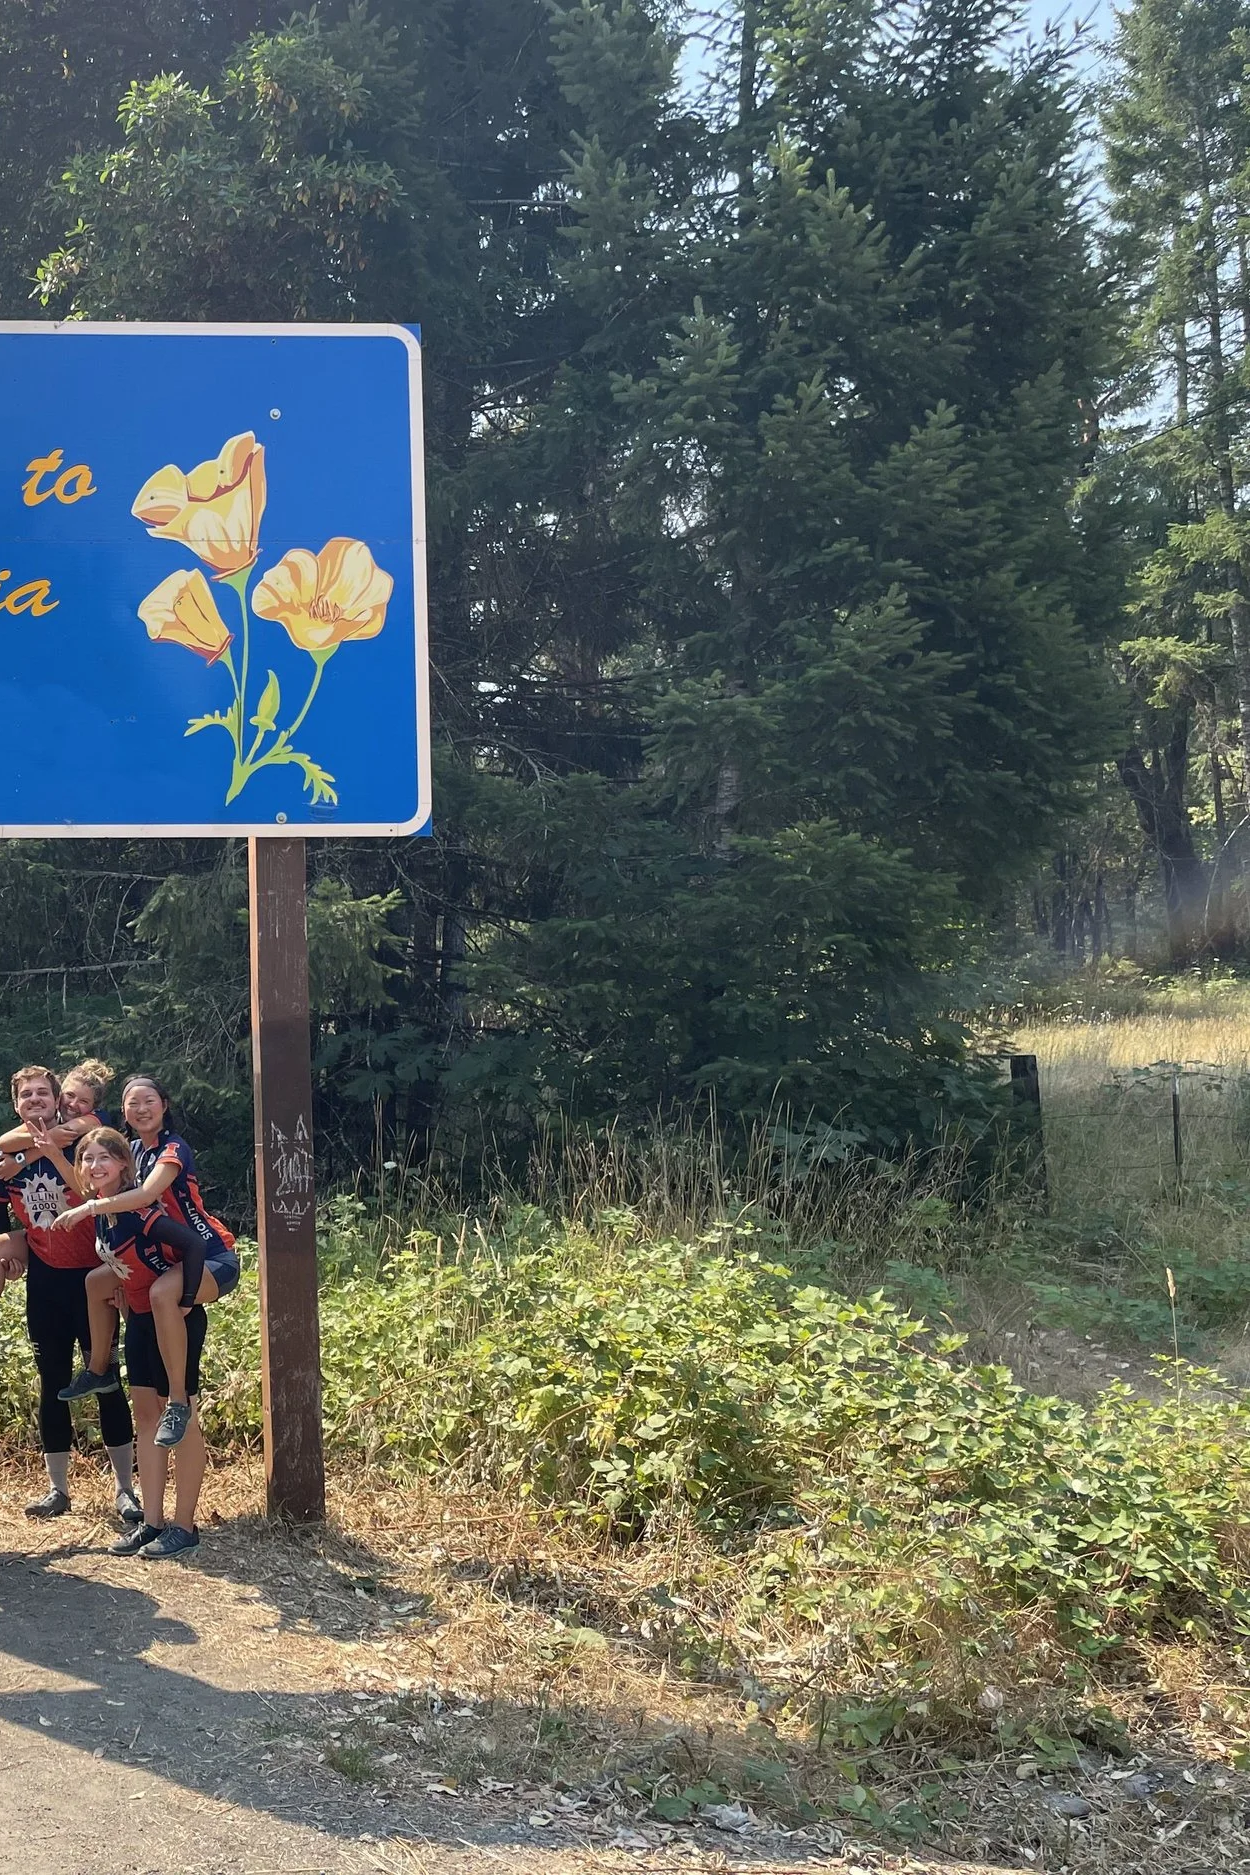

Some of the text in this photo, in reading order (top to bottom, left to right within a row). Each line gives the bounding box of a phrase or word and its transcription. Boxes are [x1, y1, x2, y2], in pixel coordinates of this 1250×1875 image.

[22, 449, 97, 507] to
[26, 1192, 59, 1203] ILLINI
[31, 1202, 57, 1211] 4000
